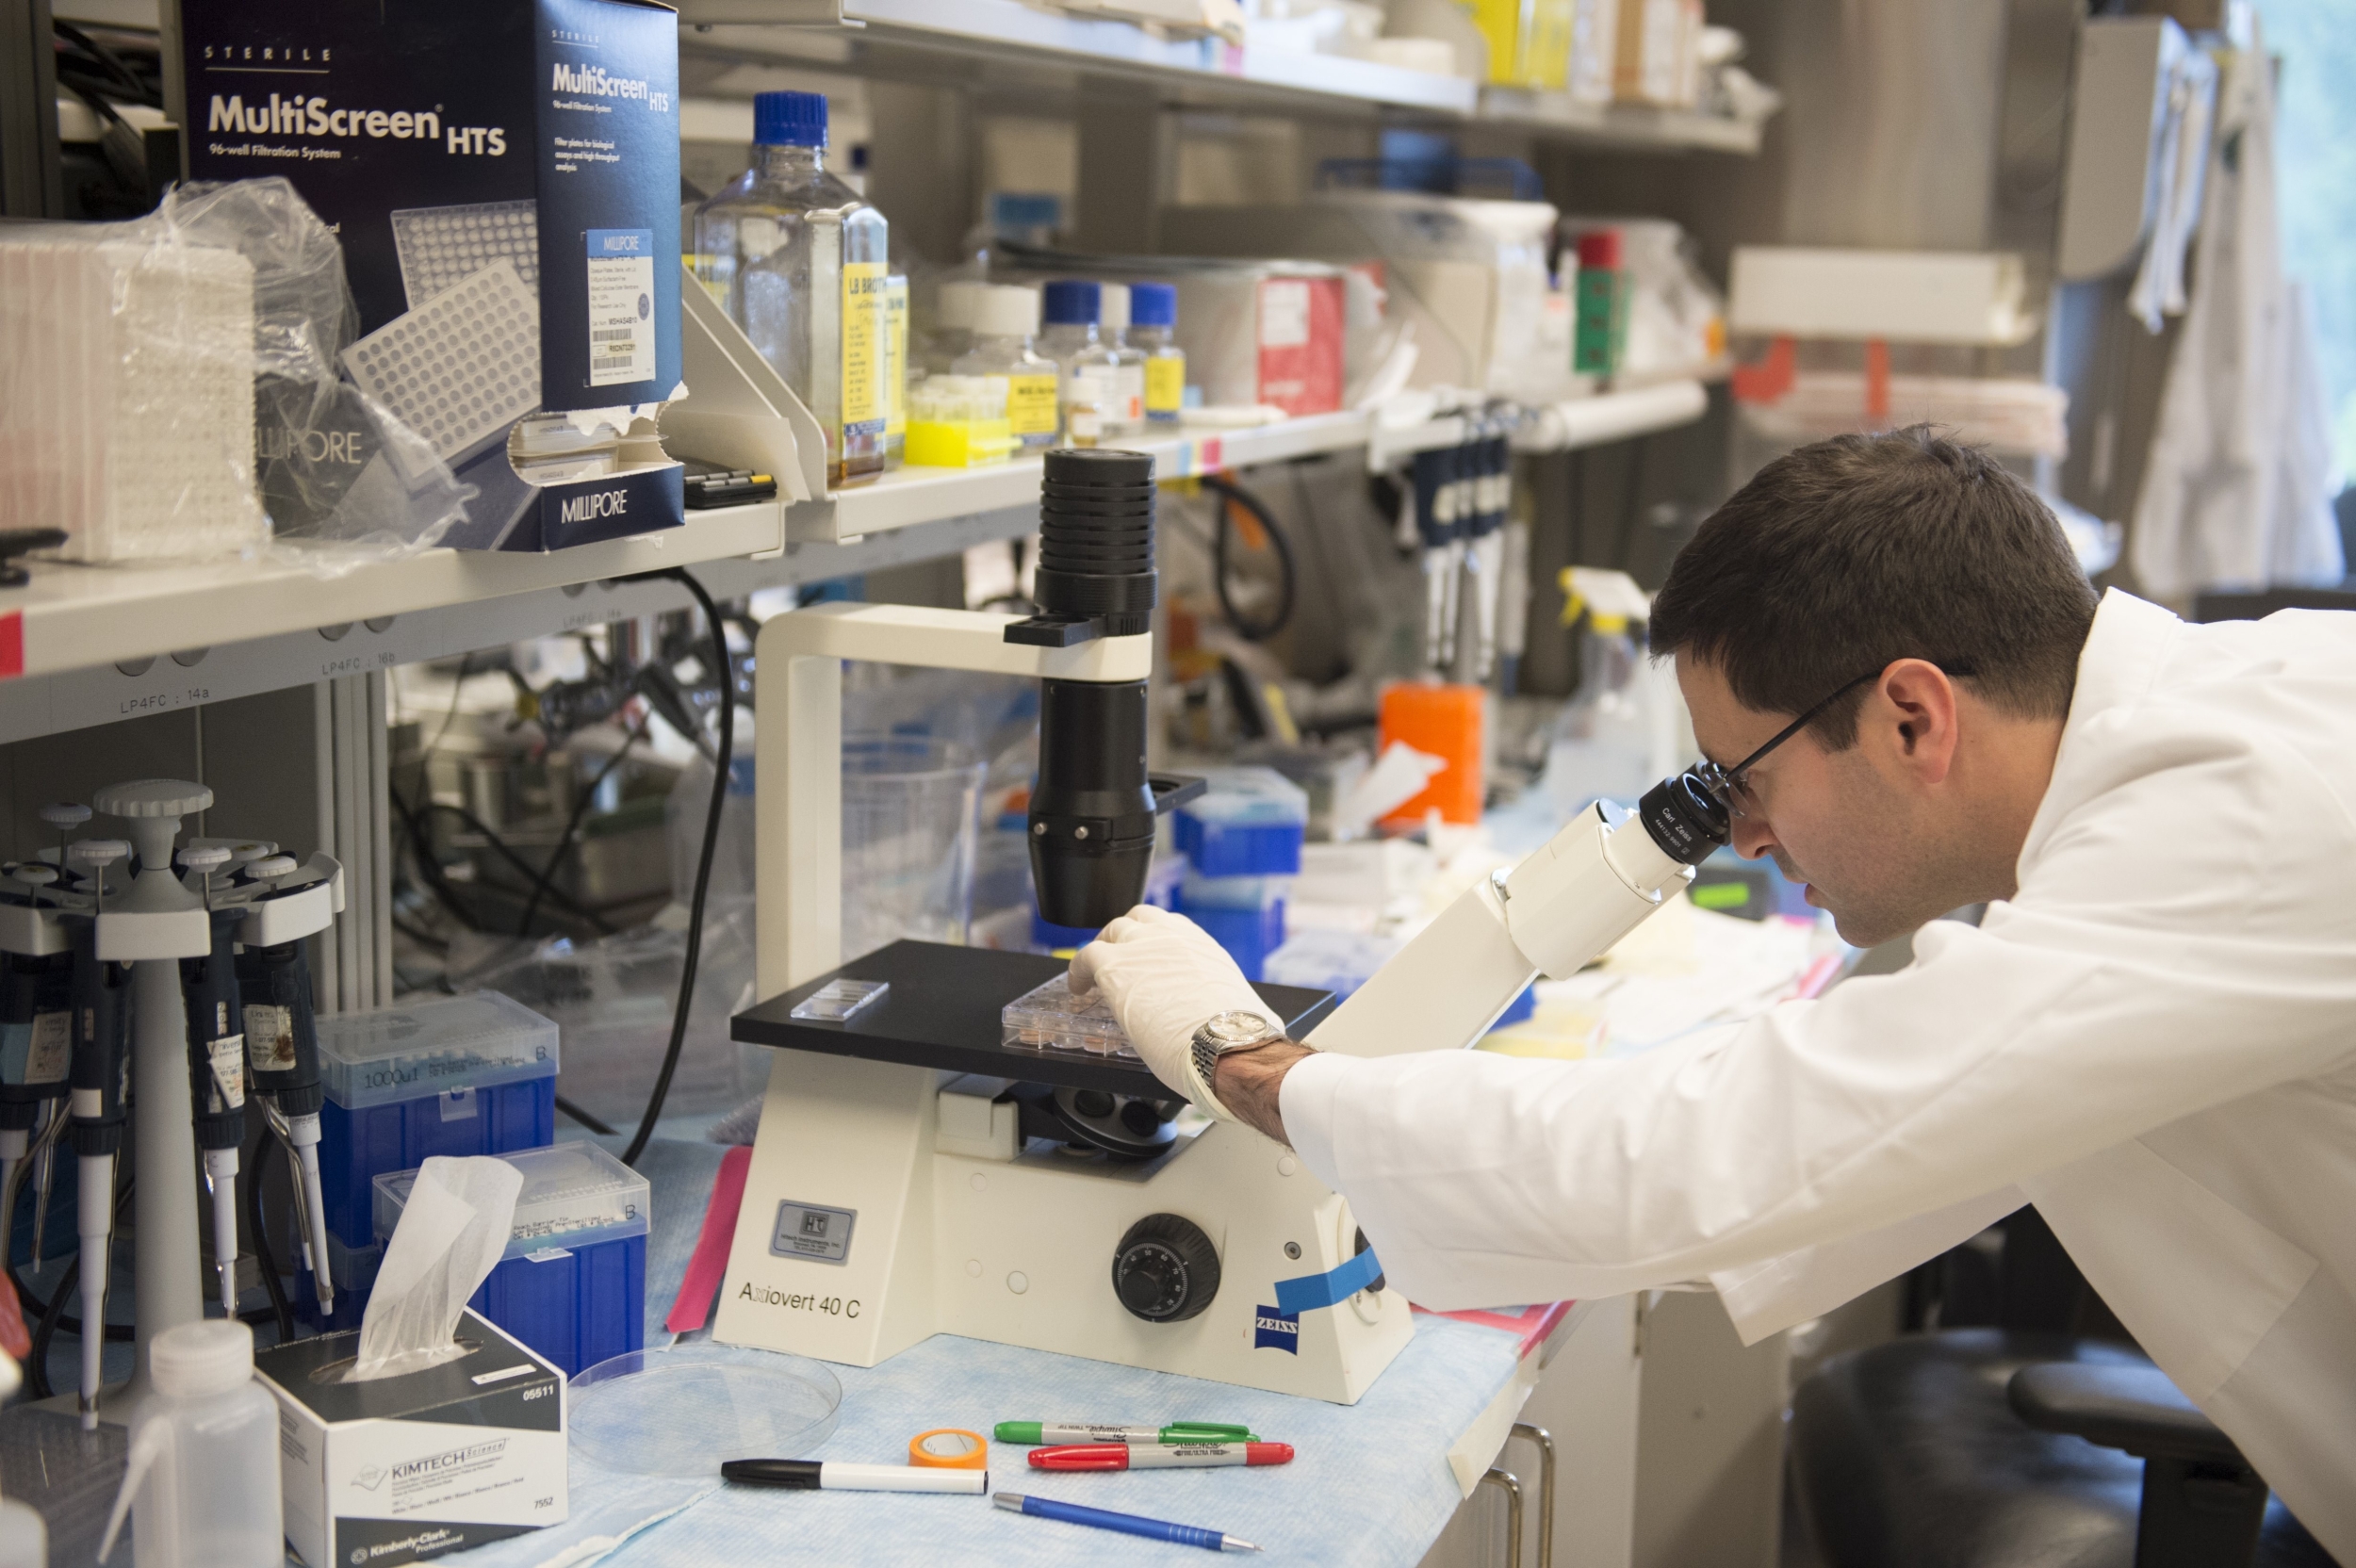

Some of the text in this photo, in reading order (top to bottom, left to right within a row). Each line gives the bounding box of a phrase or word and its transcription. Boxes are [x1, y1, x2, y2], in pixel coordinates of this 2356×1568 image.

[551, 29, 599, 43] STERILE
[205, 46, 331, 62] STERILE
[552, 62, 669, 113] MultiScreen HTS
[595, 104, 613, 114] System
[447, 126, 507, 156] HTS
[209, 143, 342, 161] 96-well Filtration System
[603, 236, 639, 252] MILLIPORE
[561, 489, 628, 524] MILLIPORE
[321, 658, 360, 676] LP4FC
[120, 694, 166, 714] LP4FC
[188, 688, 209, 702] 14a
[1662, 808, 1693, 842] Carl Zeiss
[535, 1045, 547, 1061] B
[625, 1203, 636, 1220] B
[739, 1282, 861, 1319] Axiovert 40 C
[1256, 1316, 1298, 1334] ZEISS
[522, 1383, 555, 1402] 05511
[1087, 1425, 1132, 1439] Sharpie
[392, 1451, 466, 1479] KIMTECH
[466, 1442, 503, 1458] Science
[533, 1496, 554, 1510] 7552
[369, 1528, 447, 1558] Kimberly-Clark
[415, 1534, 465, 1554] Professional
